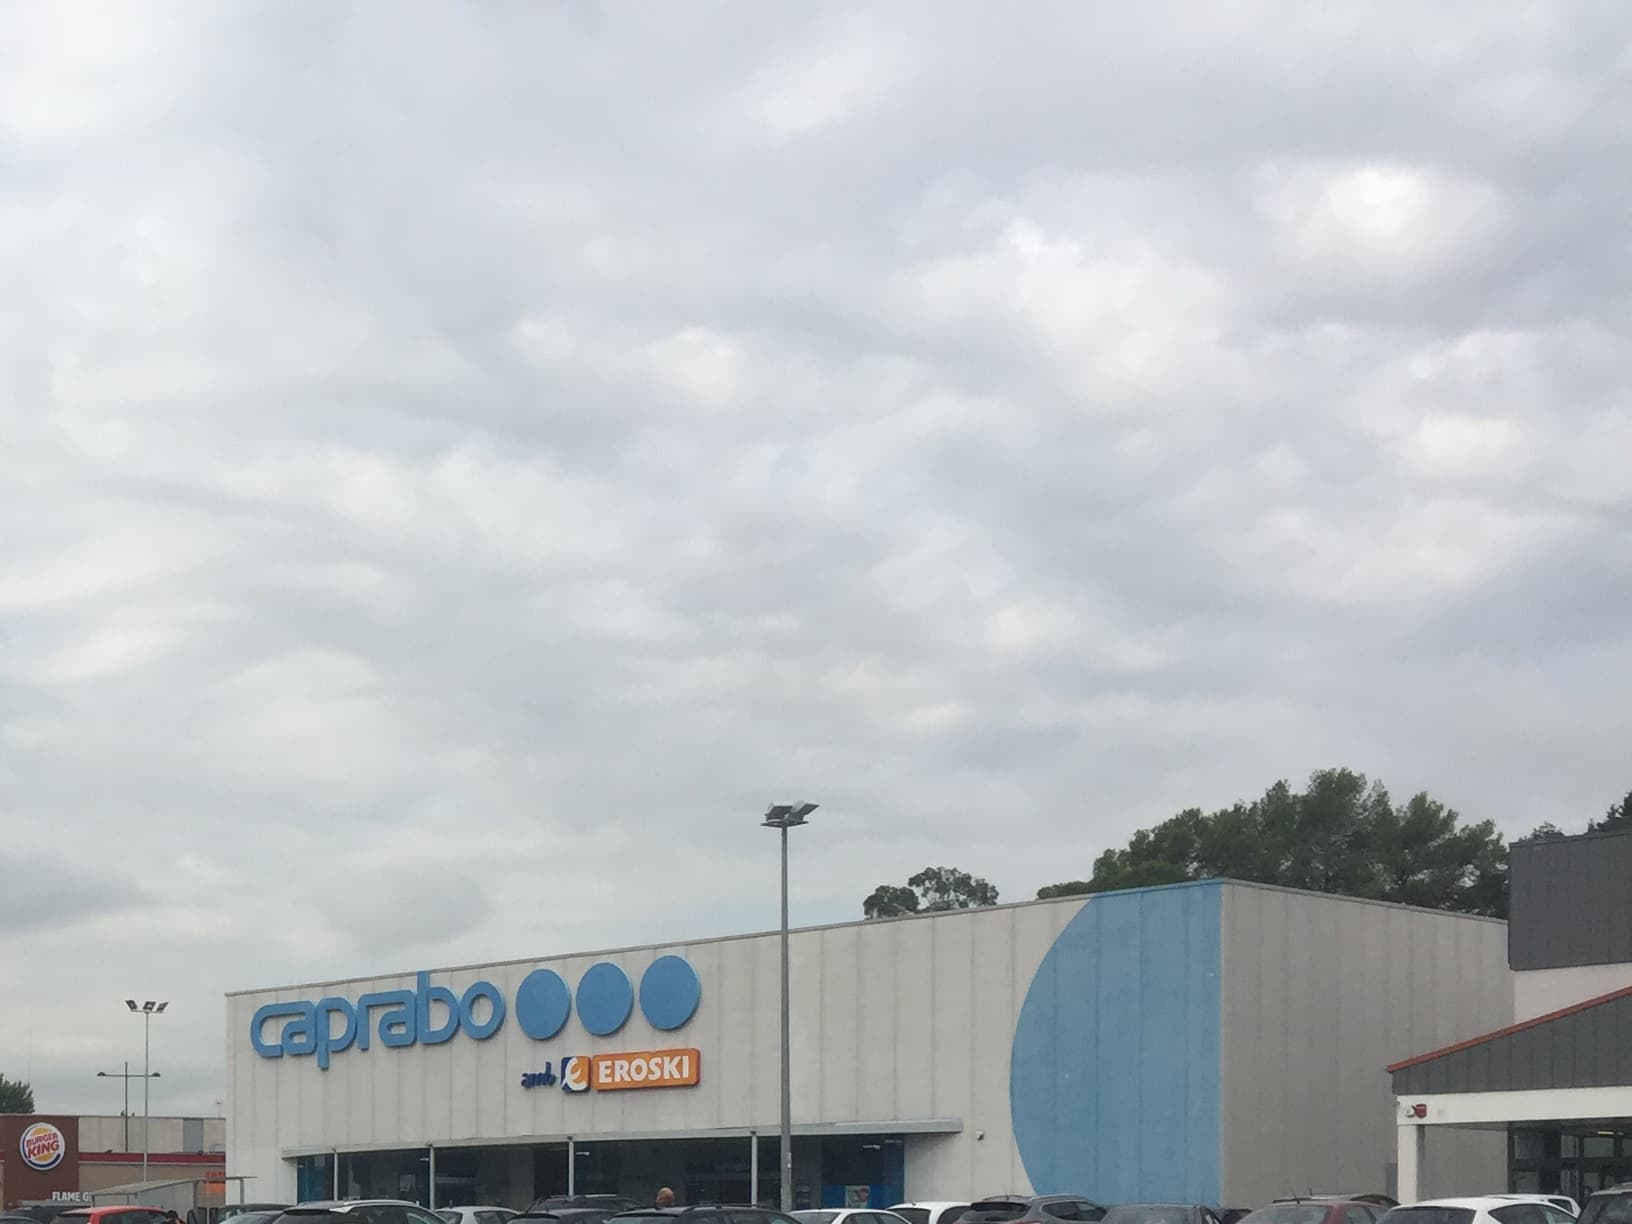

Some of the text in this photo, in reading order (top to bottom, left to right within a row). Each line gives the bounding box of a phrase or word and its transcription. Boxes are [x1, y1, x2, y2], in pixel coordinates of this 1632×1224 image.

[250, 970, 506, 1071] caprabo
[598, 1055, 690, 1084] EROSKI
[25, 1132, 59, 1148] BURGER
[27, 1140, 60, 1159] KING
[52, 1191, 81, 1201] FLAME
